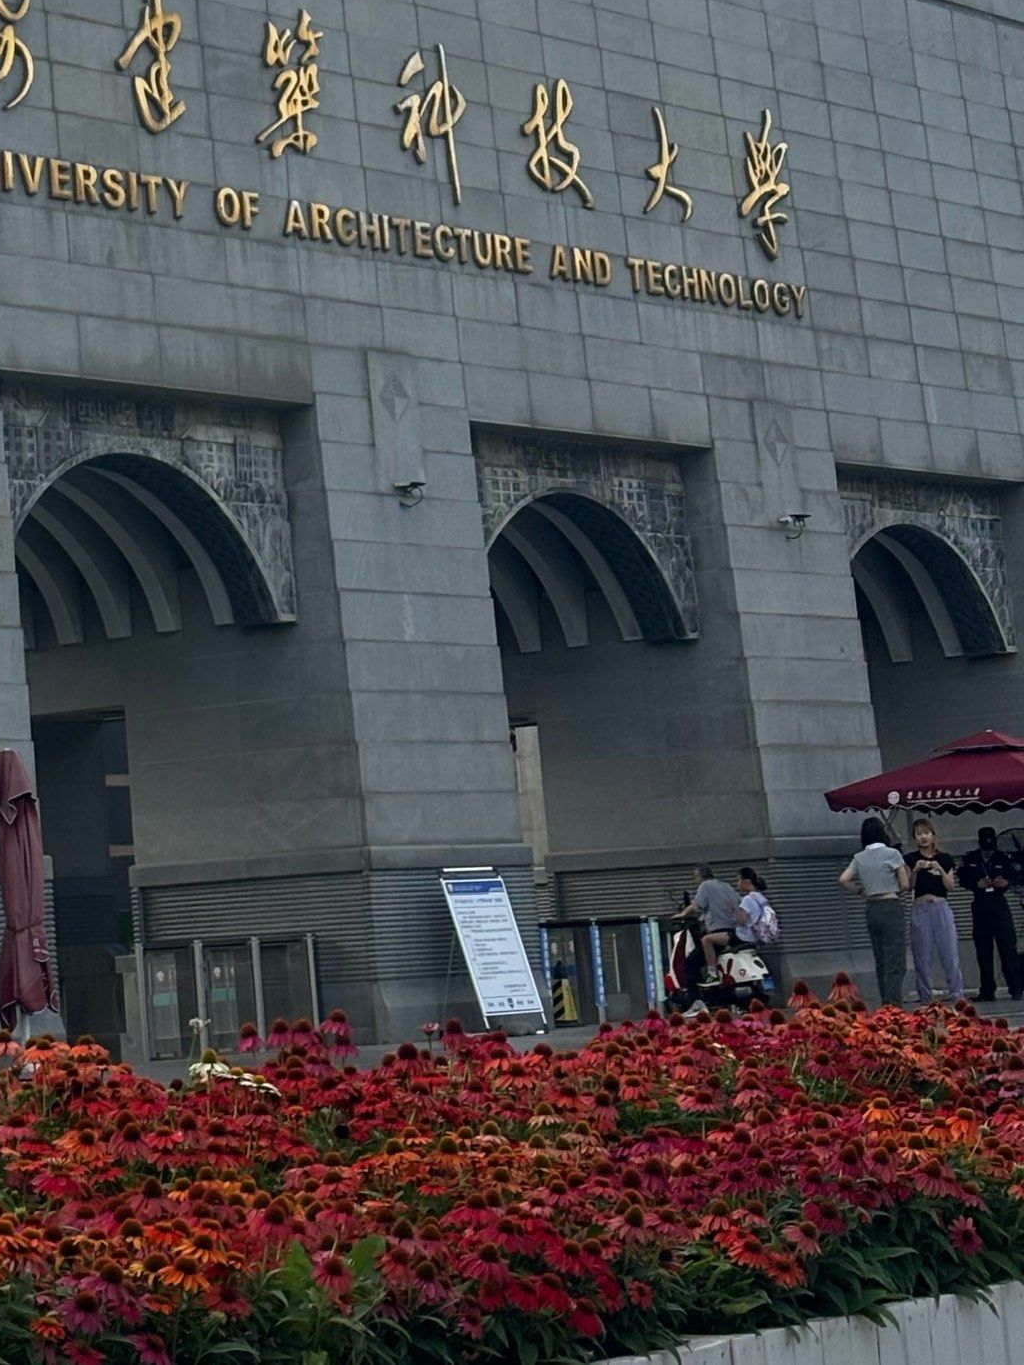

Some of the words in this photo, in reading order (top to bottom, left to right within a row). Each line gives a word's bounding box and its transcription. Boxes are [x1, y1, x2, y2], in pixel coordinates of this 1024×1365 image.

[215, 185, 260, 230] OF
[283, 199, 534, 274] ARCHITECTURE
[550, 244, 613, 287] AND
[627, 256, 808, 319] TECHNOLOGY
